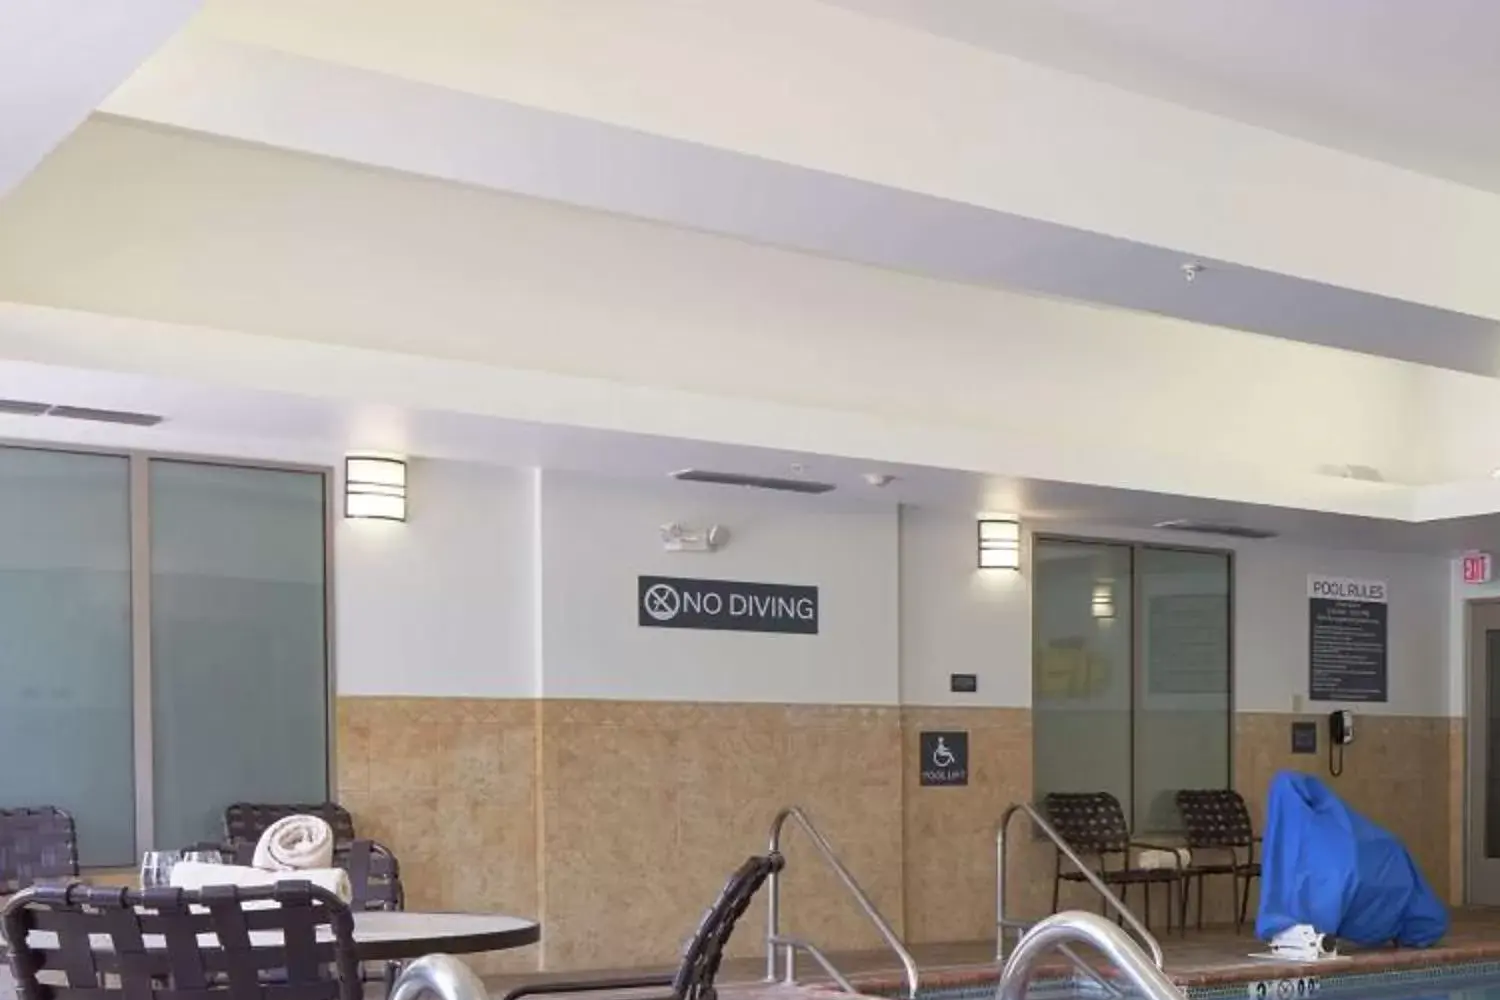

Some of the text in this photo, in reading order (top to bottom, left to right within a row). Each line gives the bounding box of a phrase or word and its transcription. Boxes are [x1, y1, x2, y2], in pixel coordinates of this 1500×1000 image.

[1313, 581, 1385, 599] POOL RULES
[682, 591, 814, 620] NO DIVING
